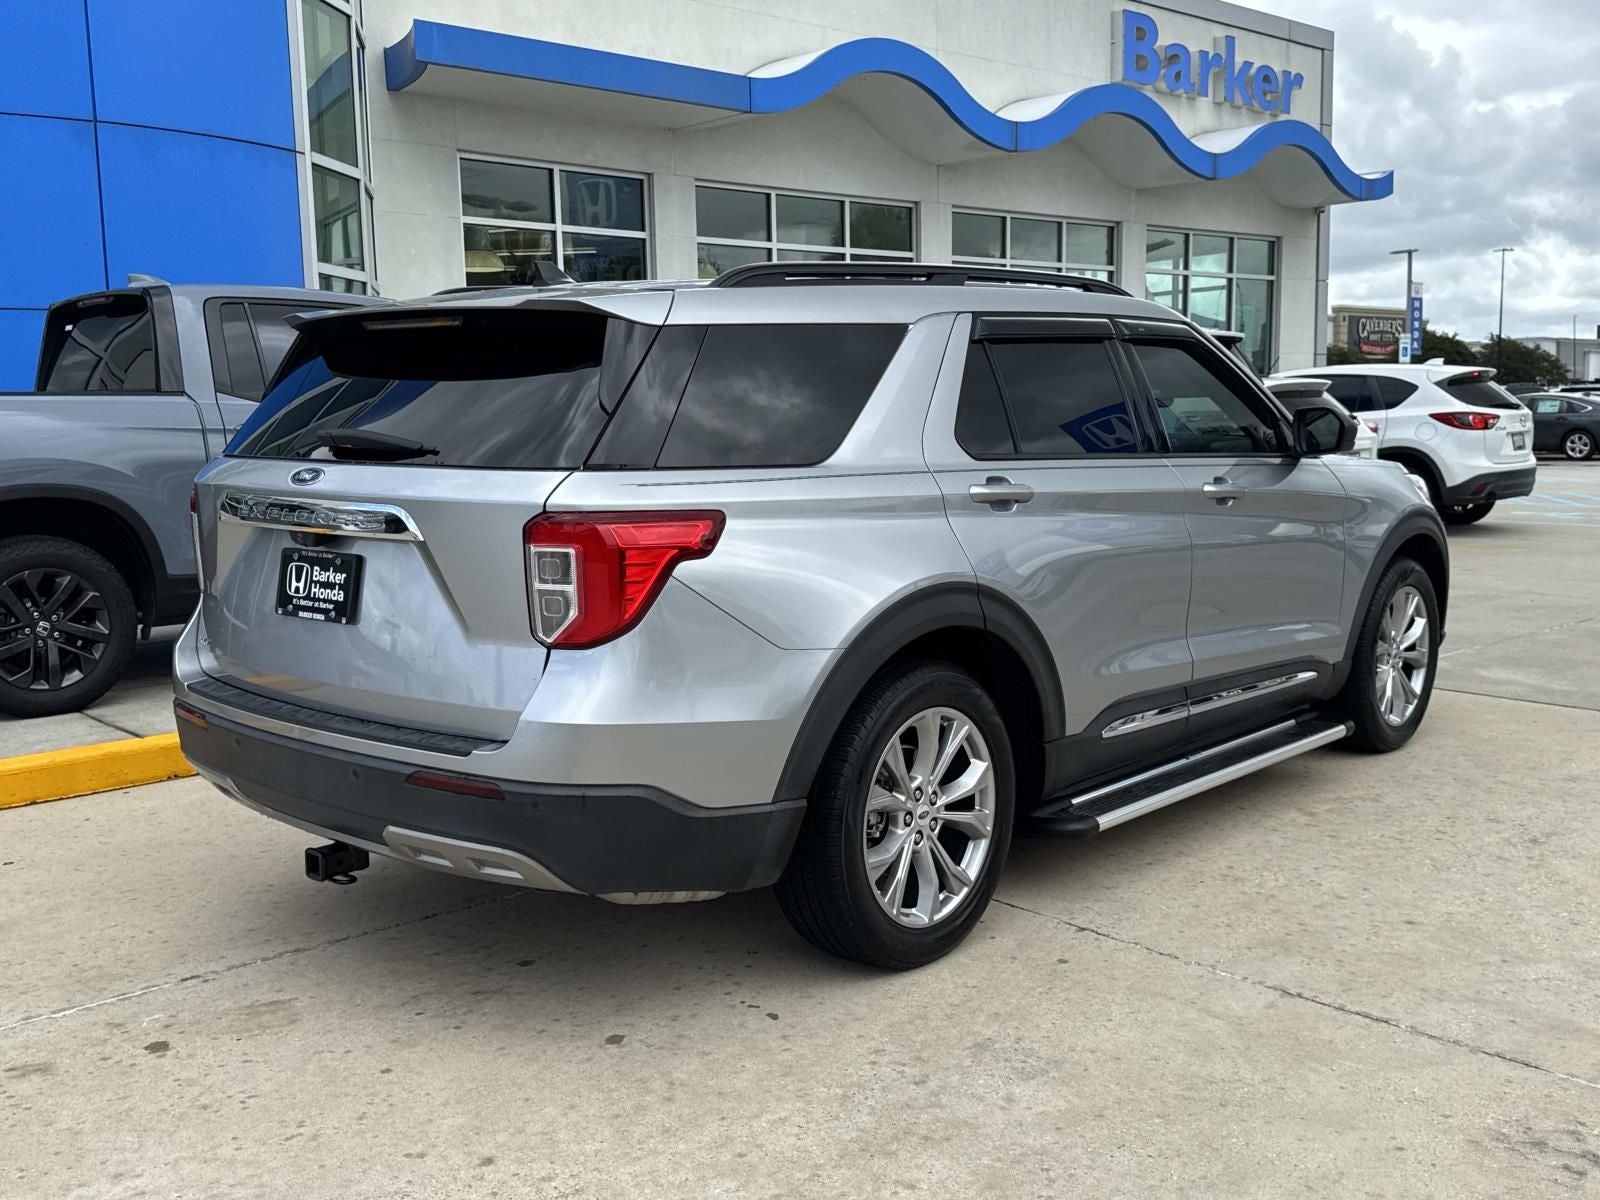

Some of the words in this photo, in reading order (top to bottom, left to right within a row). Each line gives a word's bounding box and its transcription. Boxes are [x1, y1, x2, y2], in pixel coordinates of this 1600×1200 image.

[1122, 8, 1305, 115] Barker
[1358, 317, 1403, 338] CAVENDER'S
[1412, 300, 1420, 349] HONDA
[238, 504, 368, 527] EXPLORER
[312, 565, 347, 584] Barker
[310, 583, 344, 601] Honda
